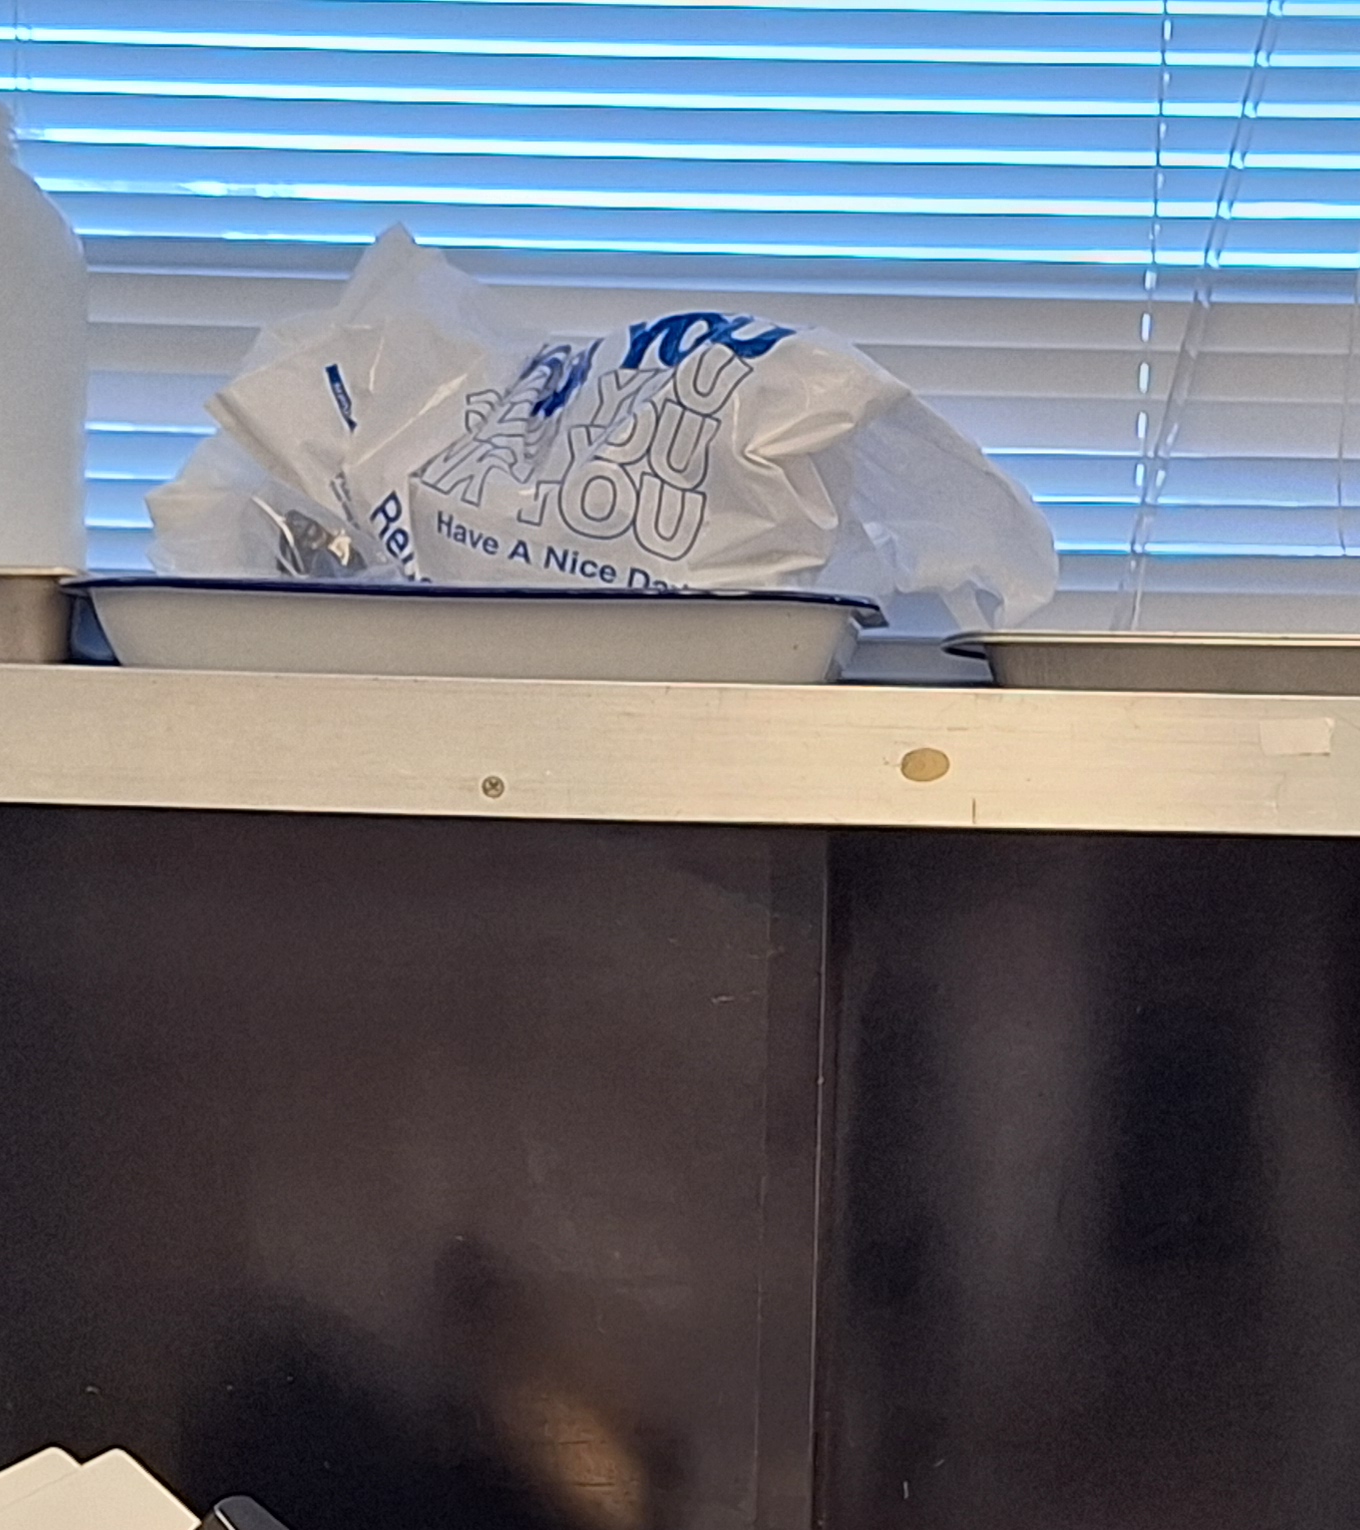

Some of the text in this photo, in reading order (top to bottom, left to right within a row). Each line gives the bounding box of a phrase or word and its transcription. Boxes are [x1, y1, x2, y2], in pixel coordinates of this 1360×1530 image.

[436, 509, 499, 556] Have
[507, 539, 532, 566] A
[543, 545, 617, 584] Nice
